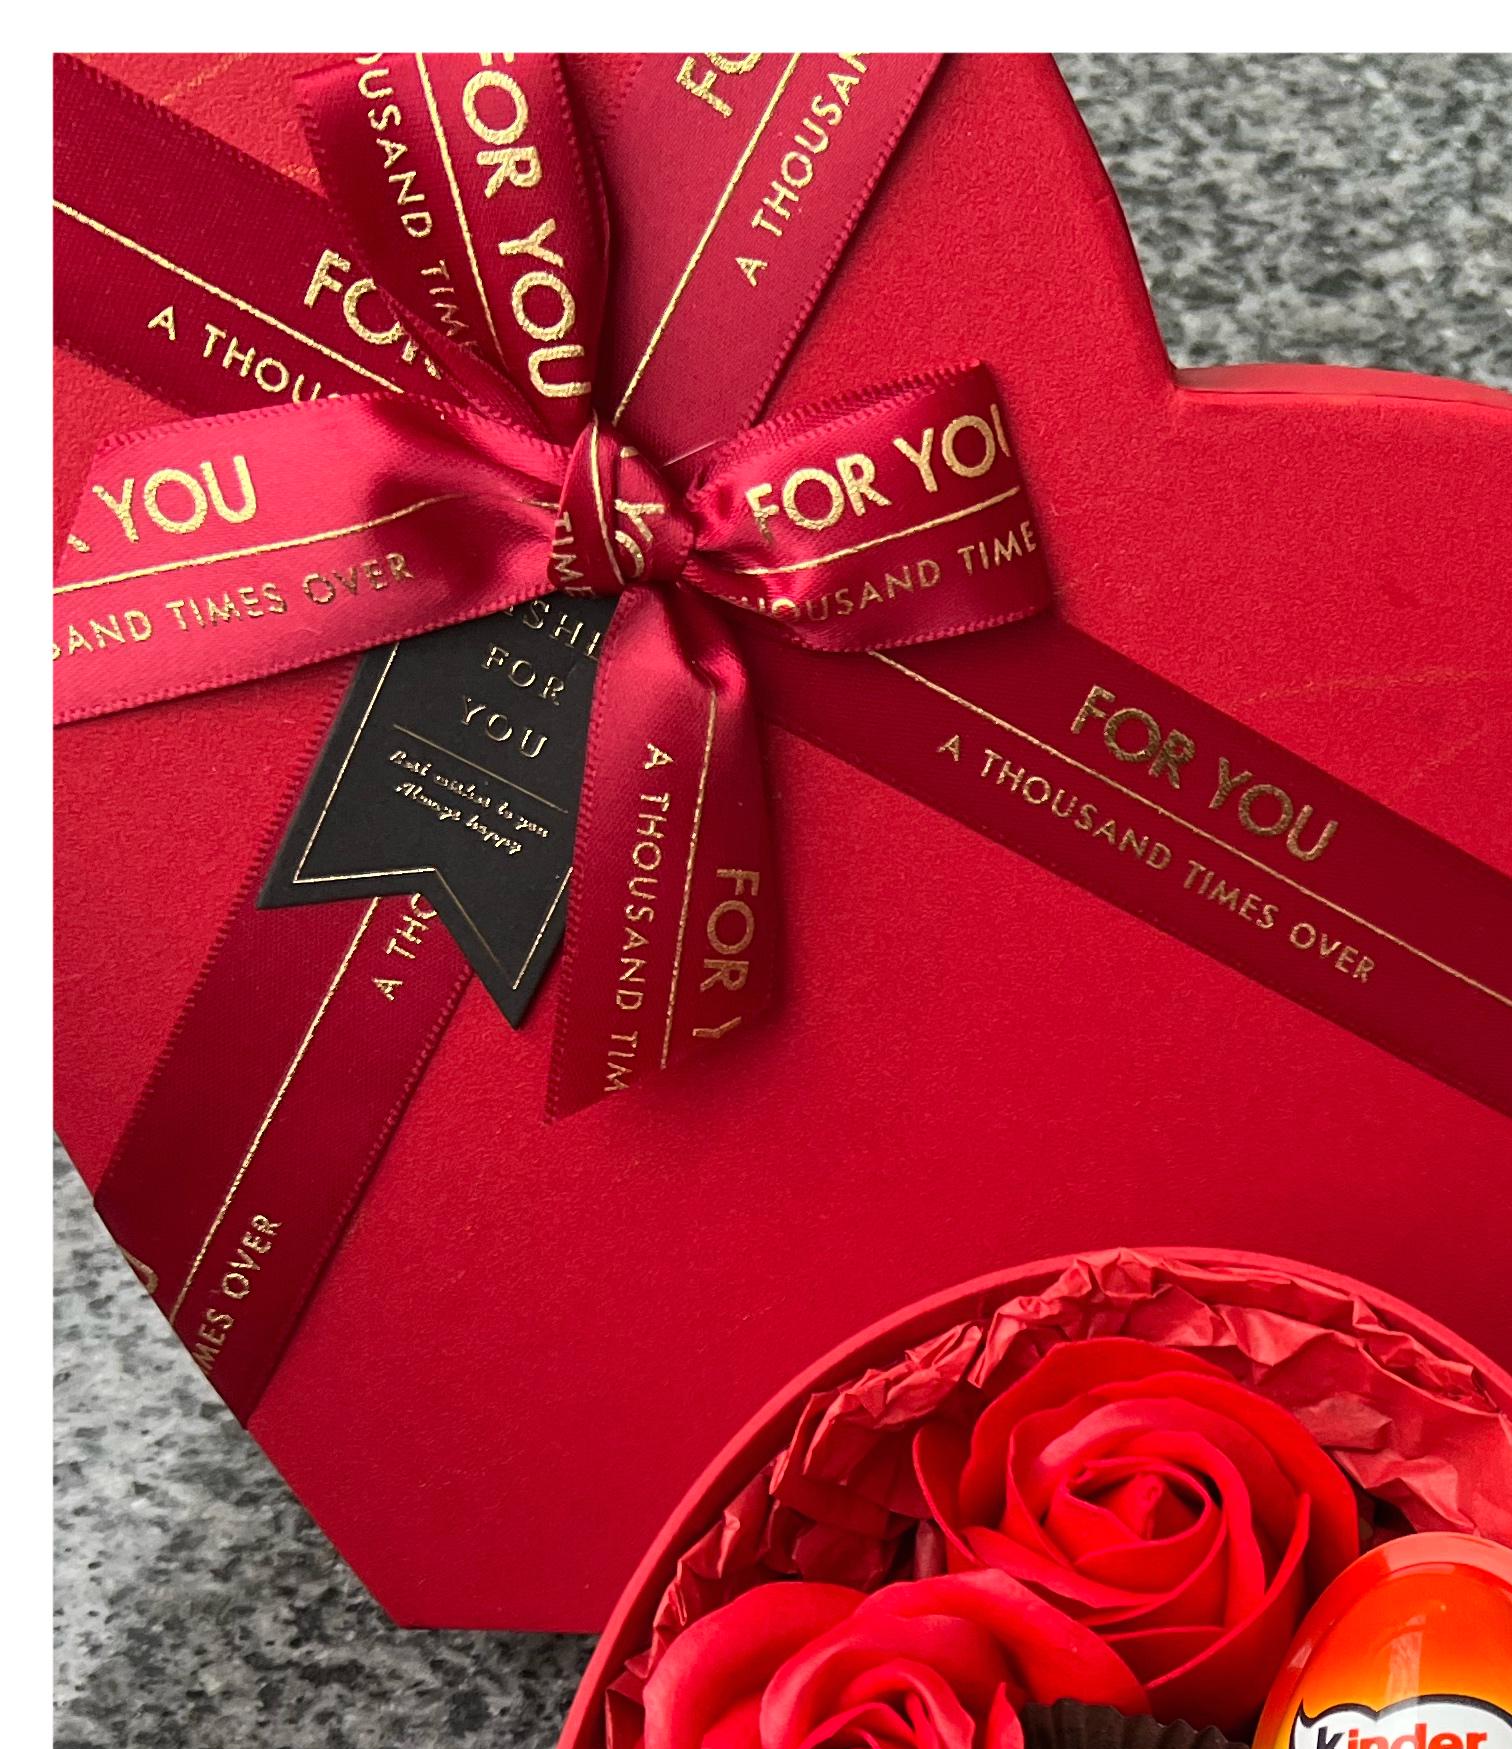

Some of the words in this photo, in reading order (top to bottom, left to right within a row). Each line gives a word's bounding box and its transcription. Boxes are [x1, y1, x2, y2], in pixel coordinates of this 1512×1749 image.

[499, 218, 592, 397] YOU
[735, 256, 768, 287] A
[147, 306, 176, 341] A
[91, 455, 257, 543] YOU
[745, 452, 892, 545] FOR
[165, 582, 288, 632] TIMES
[303, 552, 414, 605] OVER
[481, 645, 566, 706] FOR
[461, 695, 548, 758] YOU
[644, 742, 674, 770] A
[1070, 684, 1196, 790] FOR
[1208, 756, 1340, 863] YOU
[464, 814, 523, 856] happy
[937, 734, 962, 763] A
[978, 748, 1173, 871] THOUSAND
[1182, 859, 1280, 930] TIMES
[1289, 922, 1376, 984] OVER
[615, 793, 671, 1012] THOUSAND
[700, 867, 760, 993] FOR
[371, 977, 404, 1001] A
[222, 1214, 283, 1300] OVER
